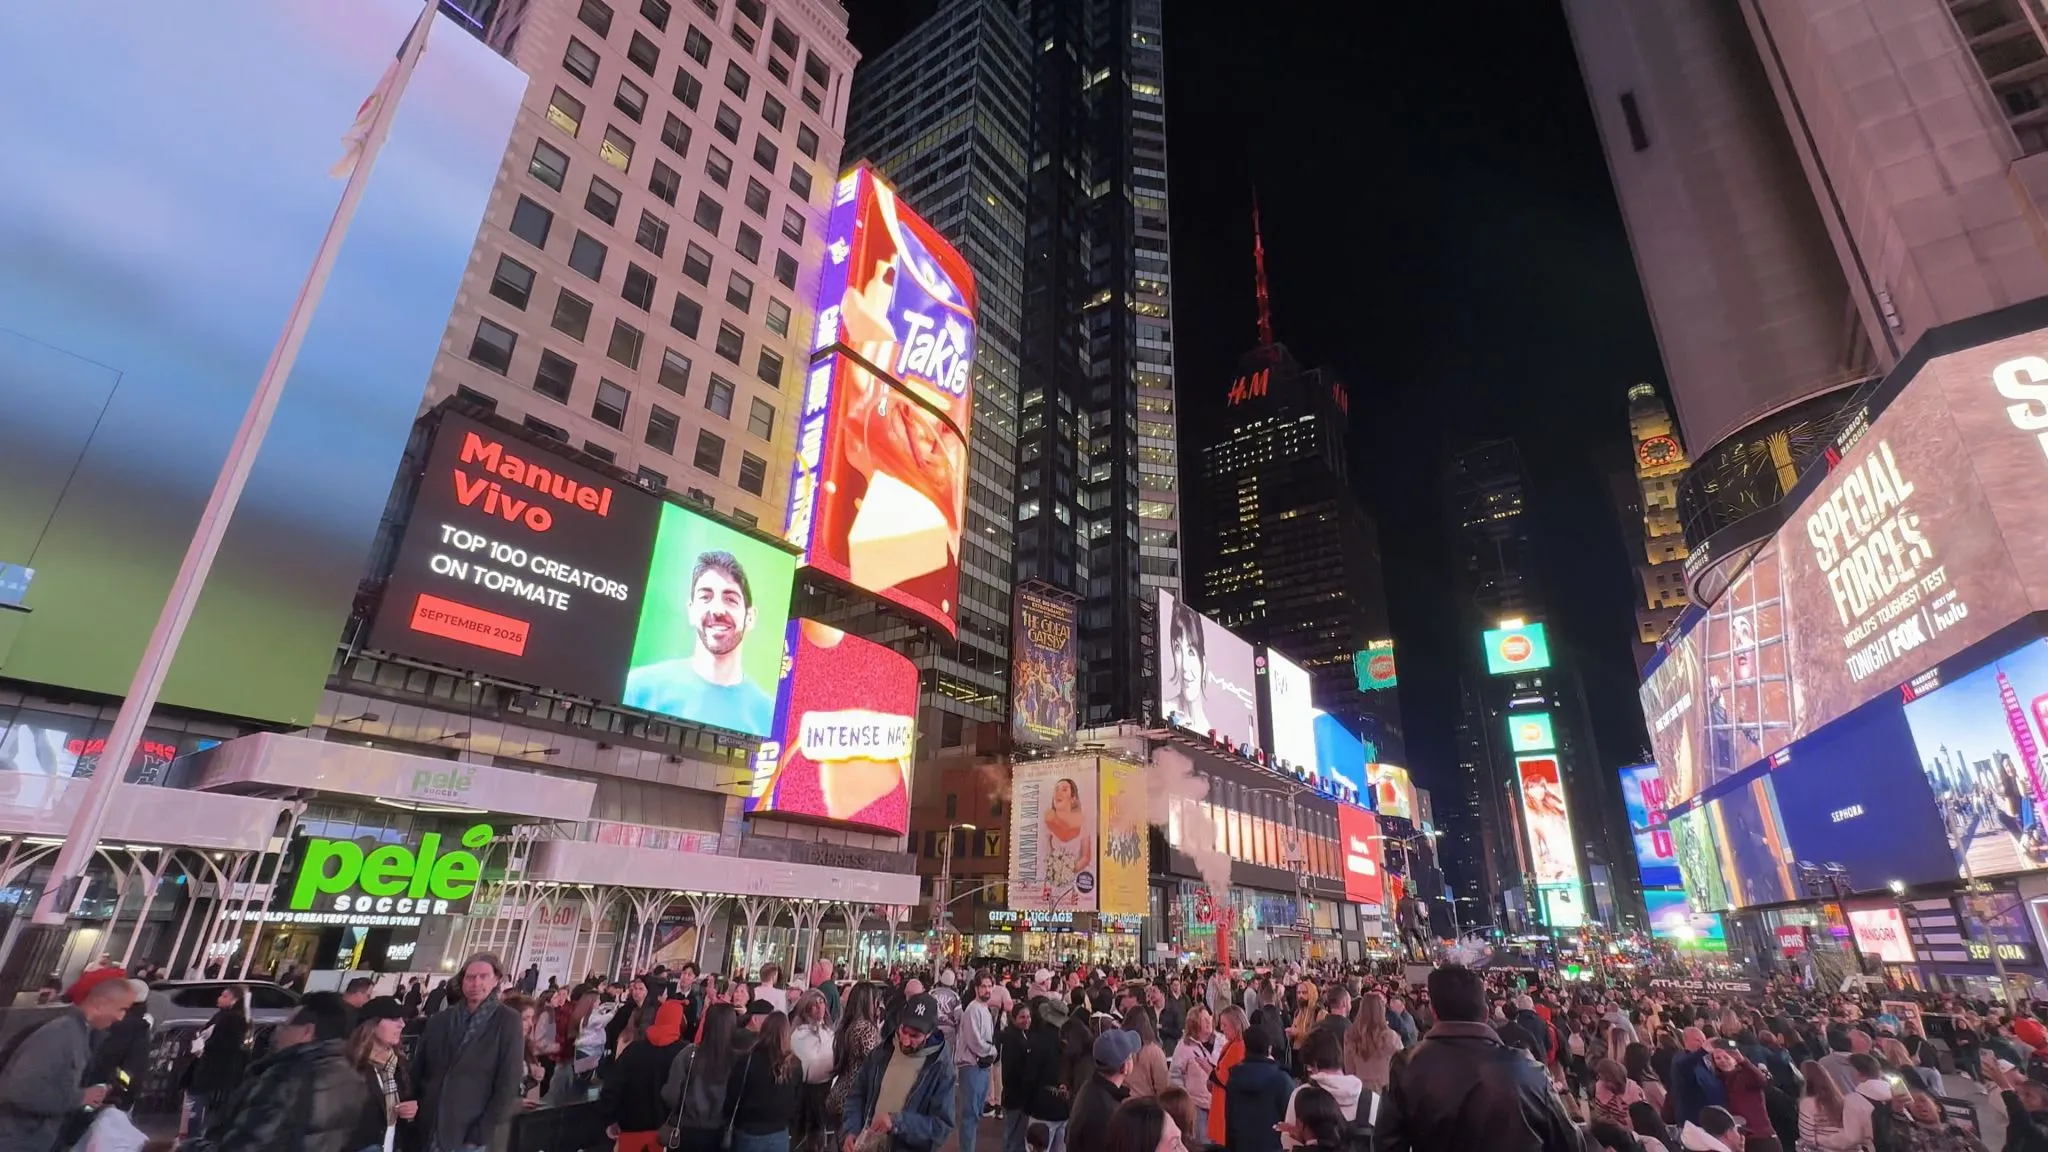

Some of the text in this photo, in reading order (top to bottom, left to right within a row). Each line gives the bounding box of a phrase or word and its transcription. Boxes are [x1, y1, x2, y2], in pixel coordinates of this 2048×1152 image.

[897, 309, 969, 395] Takis
[1837, 406, 1869, 446] MARRIOTT
[1840, 421, 1869, 457] MARQUIS
[459, 431, 613, 519] Manuel
[453, 469, 554, 533] Vivo
[1807, 439, 1915, 572] SPECIAL
[440, 523, 629, 602] TOP 100 CREATORS
[1827, 507, 1933, 628] FORCES
[430, 554, 571, 612] ON TOPMATE
[1843, 565, 1947, 649] WORLD'S TOUGHEST TEST
[1933, 601, 1969, 632] hulu
[418, 606, 524, 645] SEPTEMBER 2025
[1022, 610, 1040, 629] THE
[1041, 618, 1071, 640] GREAT
[1028, 628, 1067, 650] GATSBY
[1846, 613, 1928, 683] TONIGHT FOX
[1256, 667, 1266, 675] LG
[1911, 668, 1939, 688] MARRIOTT
[1914, 679, 1939, 696] MARQUIS
[806, 725, 913, 748] INTENSE NAC
[411, 767, 477, 793] pelé
[1831, 804, 1863, 823] SEPHORA
[290, 824, 494, 909] pelé
[293, 913, 349, 924] GREATEST
[349, 915, 389, 926] SOCCER
[389, 916, 421, 927] STORE
[333, 895, 448, 916] SOCCER
[989, 911, 1018, 922] GIFTS
[1024, 911, 1073, 923] LUGGAGE
[1859, 927, 1897, 941] PANDORA
[1969, 944, 2025, 960] SEPORA
[1650, 979, 1703, 989] ATHLOS
